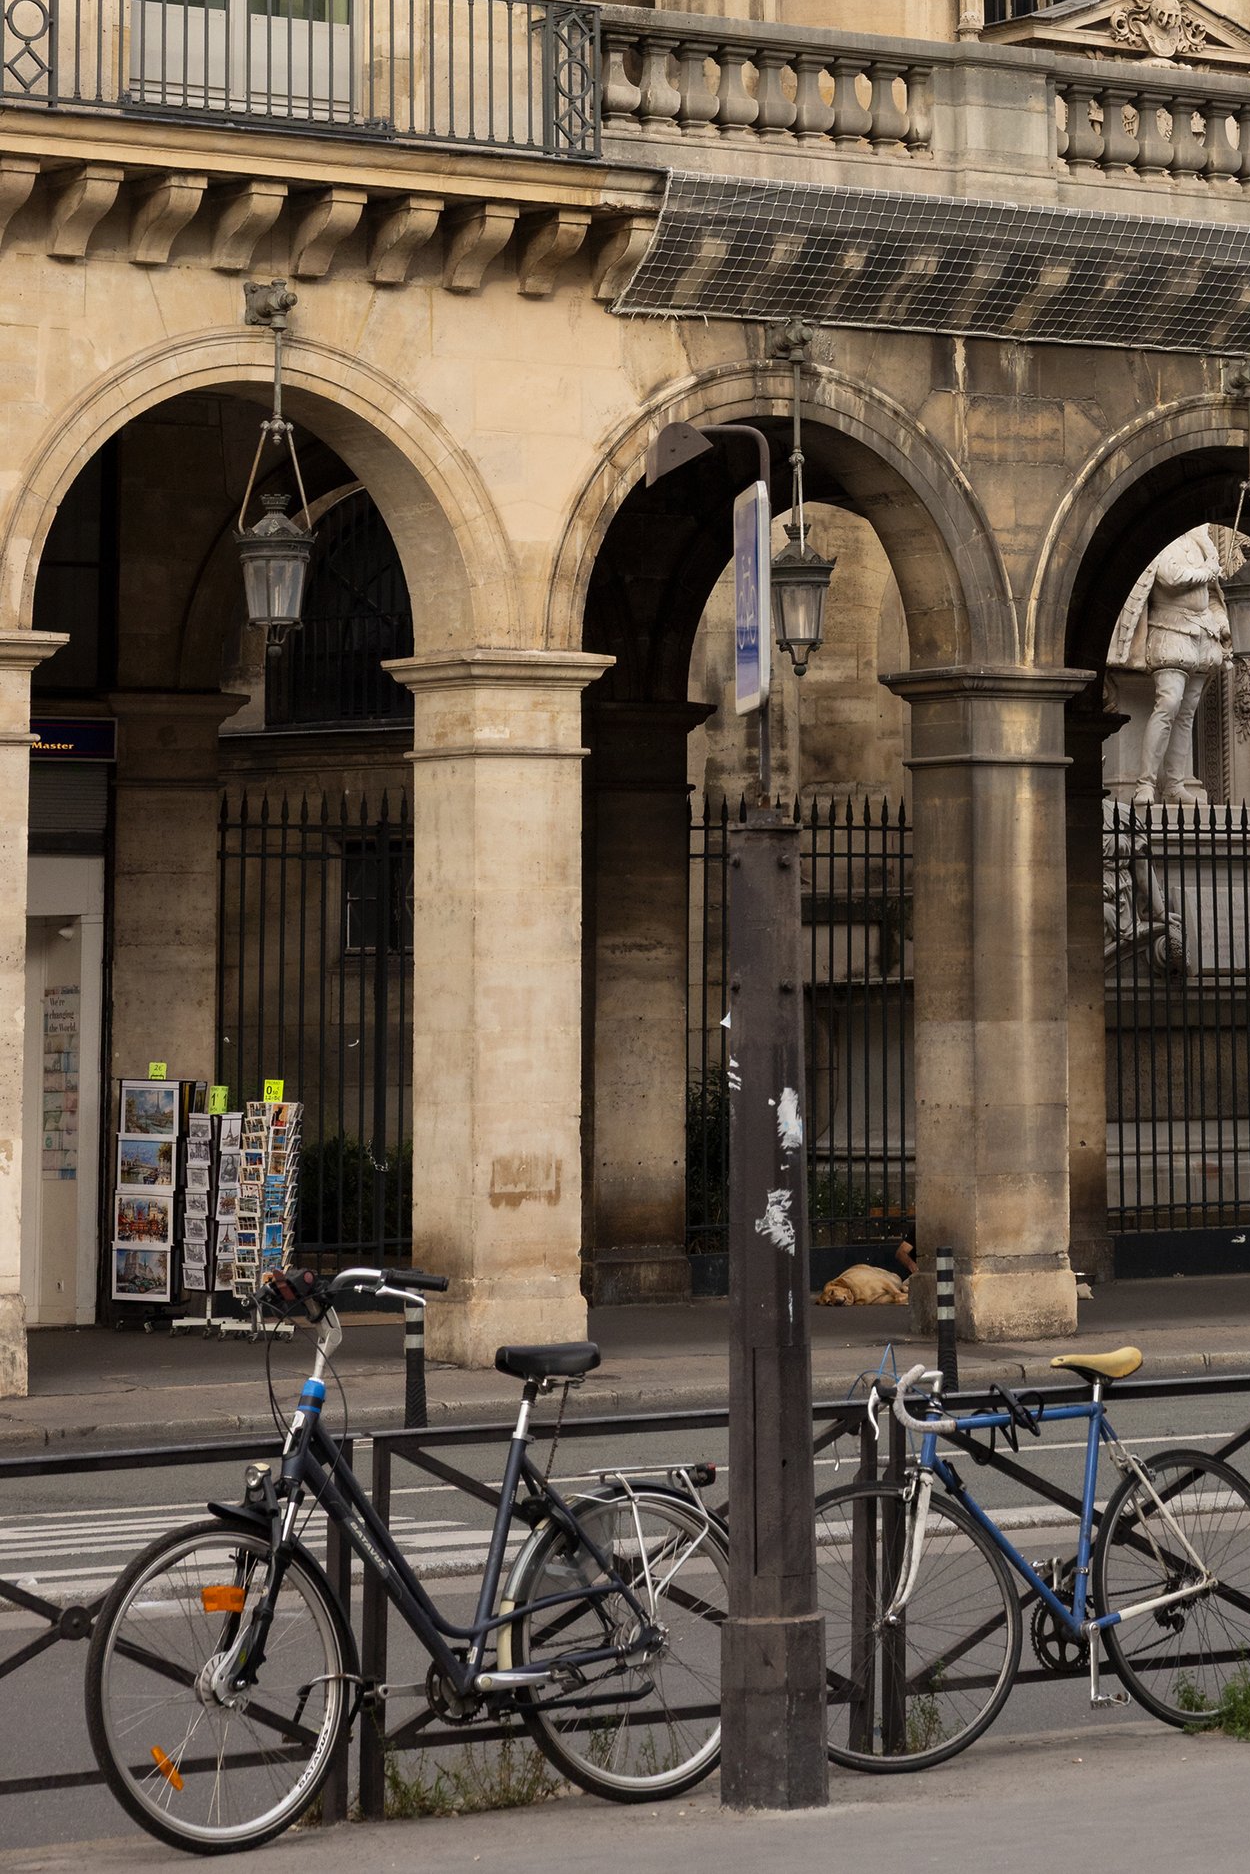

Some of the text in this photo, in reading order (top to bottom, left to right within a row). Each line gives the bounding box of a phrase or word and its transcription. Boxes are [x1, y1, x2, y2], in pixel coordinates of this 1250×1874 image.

[31, 741, 74, 750] Master
[49, 997, 65, 1006] We're
[49, 1010, 74, 1020] changing
[49, 1023, 58, 1032] the
[350, 1521, 387, 1569] BATAVUS
[299, 1728, 329, 1788] BATAVUS
